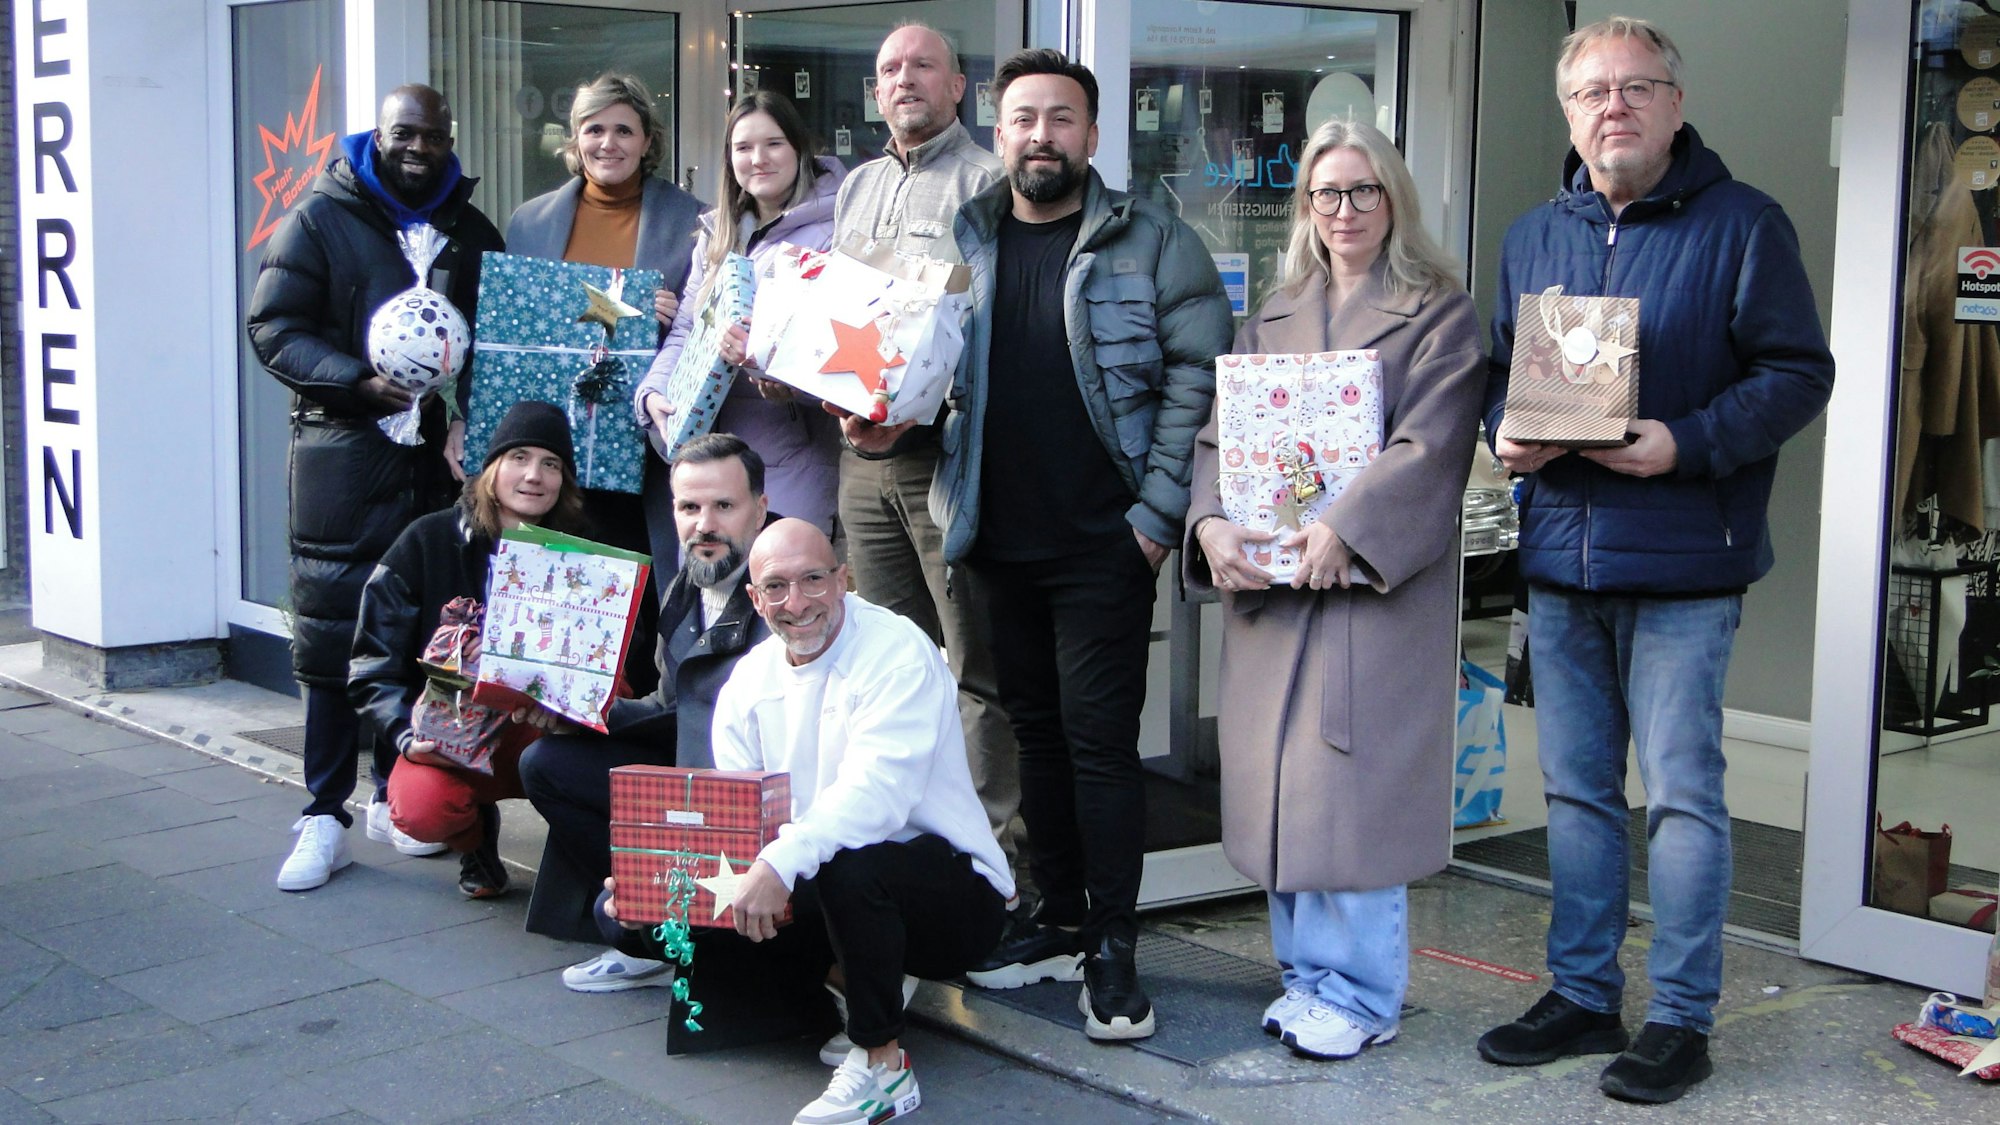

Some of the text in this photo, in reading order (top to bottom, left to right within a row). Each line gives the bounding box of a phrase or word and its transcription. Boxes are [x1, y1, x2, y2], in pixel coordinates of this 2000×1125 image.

[271, 167, 293, 199] Hair
[282, 165, 315, 209] Botox
[1961, 280, 2000, 294] Hotspot
